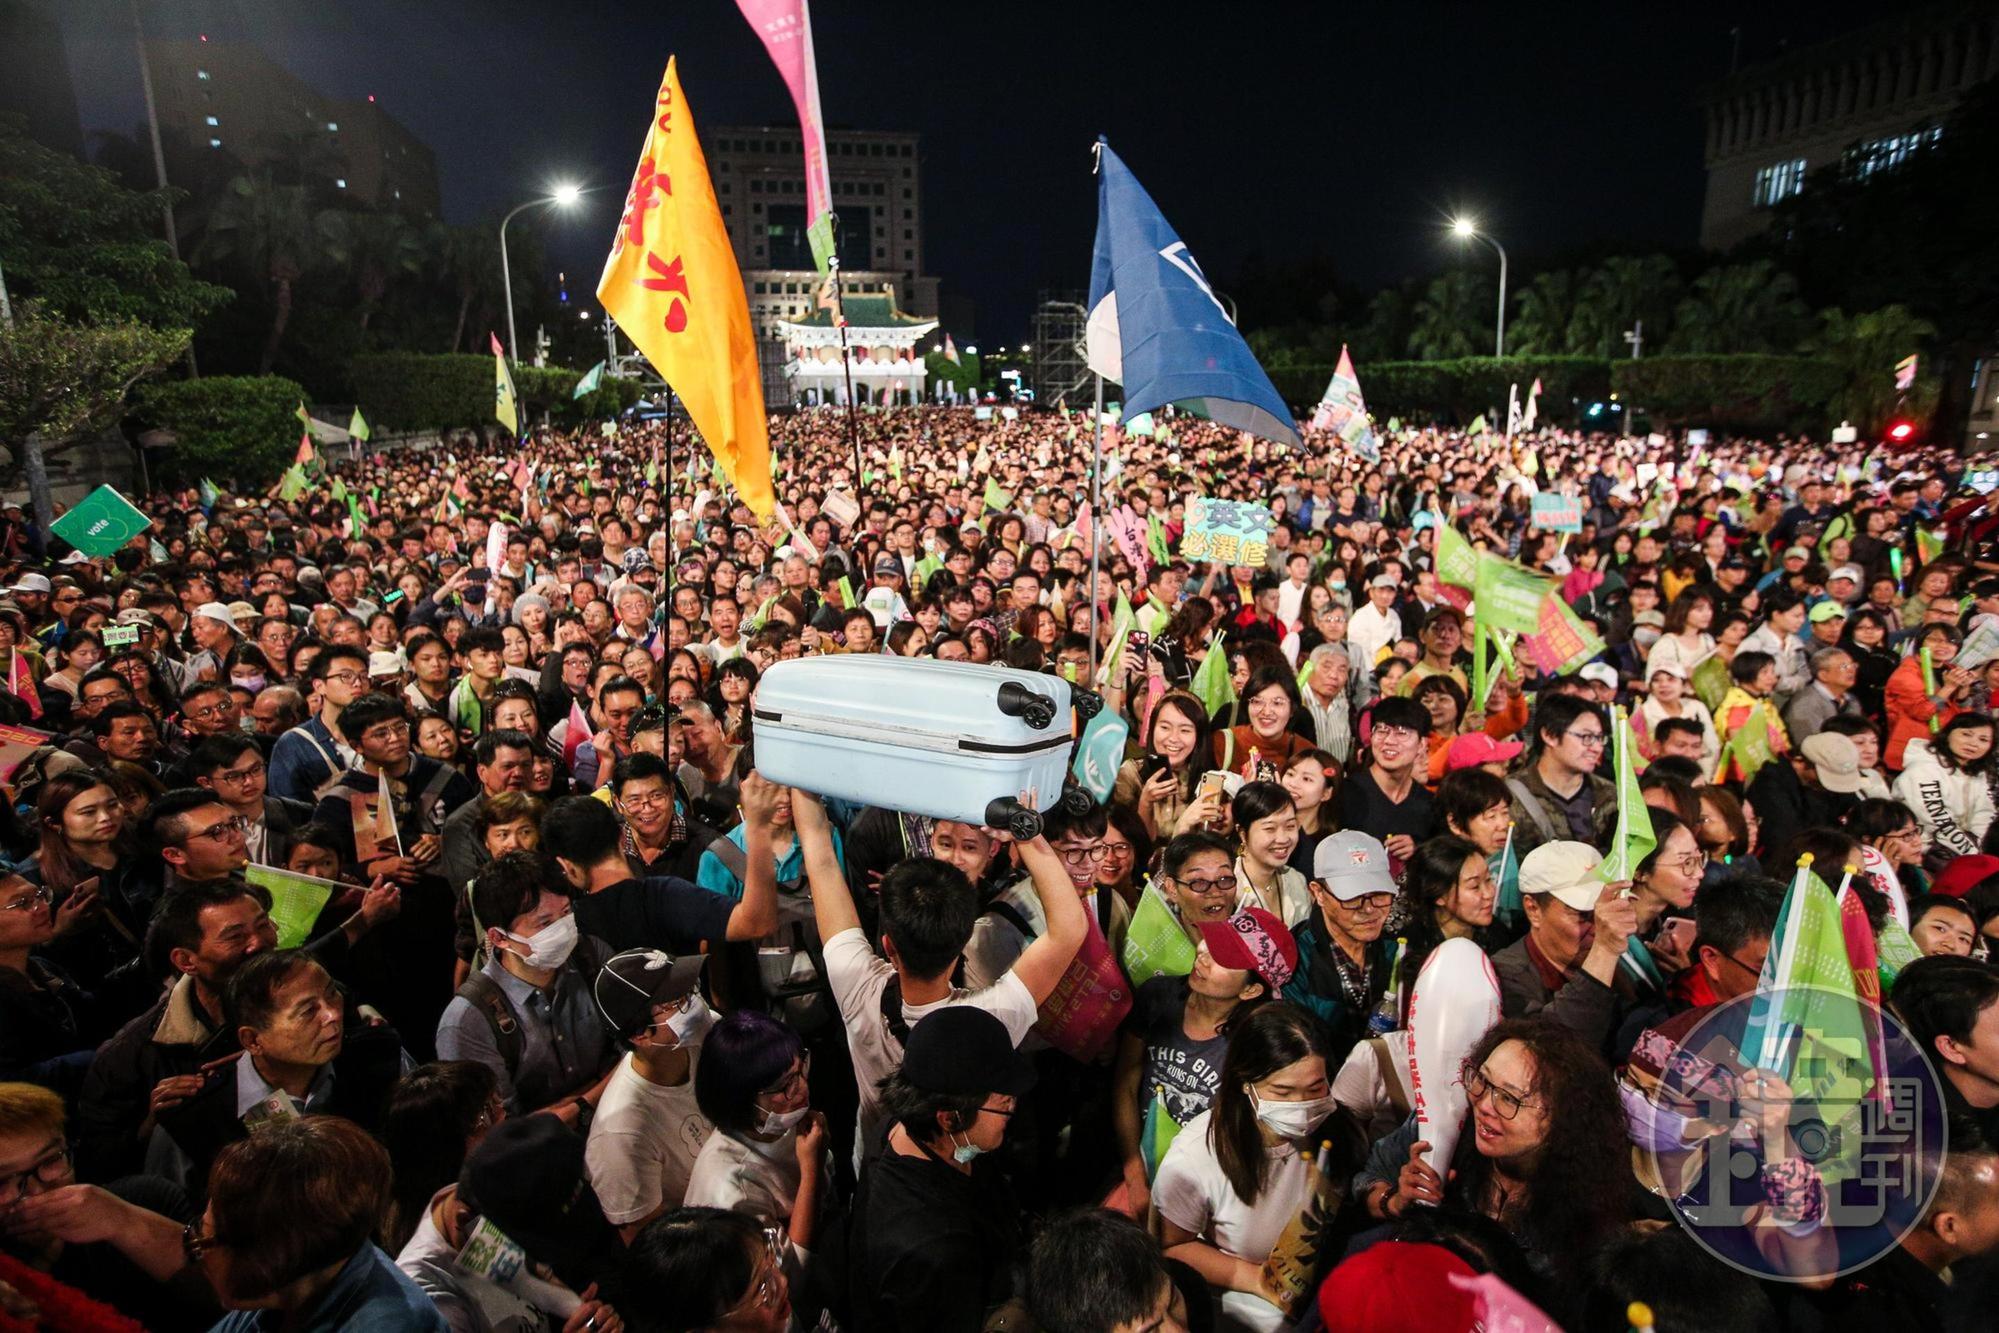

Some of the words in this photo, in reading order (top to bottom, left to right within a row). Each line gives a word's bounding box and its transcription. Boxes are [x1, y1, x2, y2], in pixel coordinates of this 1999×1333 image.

[87, 518, 110, 537] vote
[1207, 500, 1276, 534] 英文
[1179, 529, 1269, 567] 必選修
[1148, 1046, 1186, 1064] THIS
[1192, 1058, 1221, 1095] GIRL
[1167, 1064, 1187, 1083] RUNS
[1186, 1075, 1199, 1089] ON
